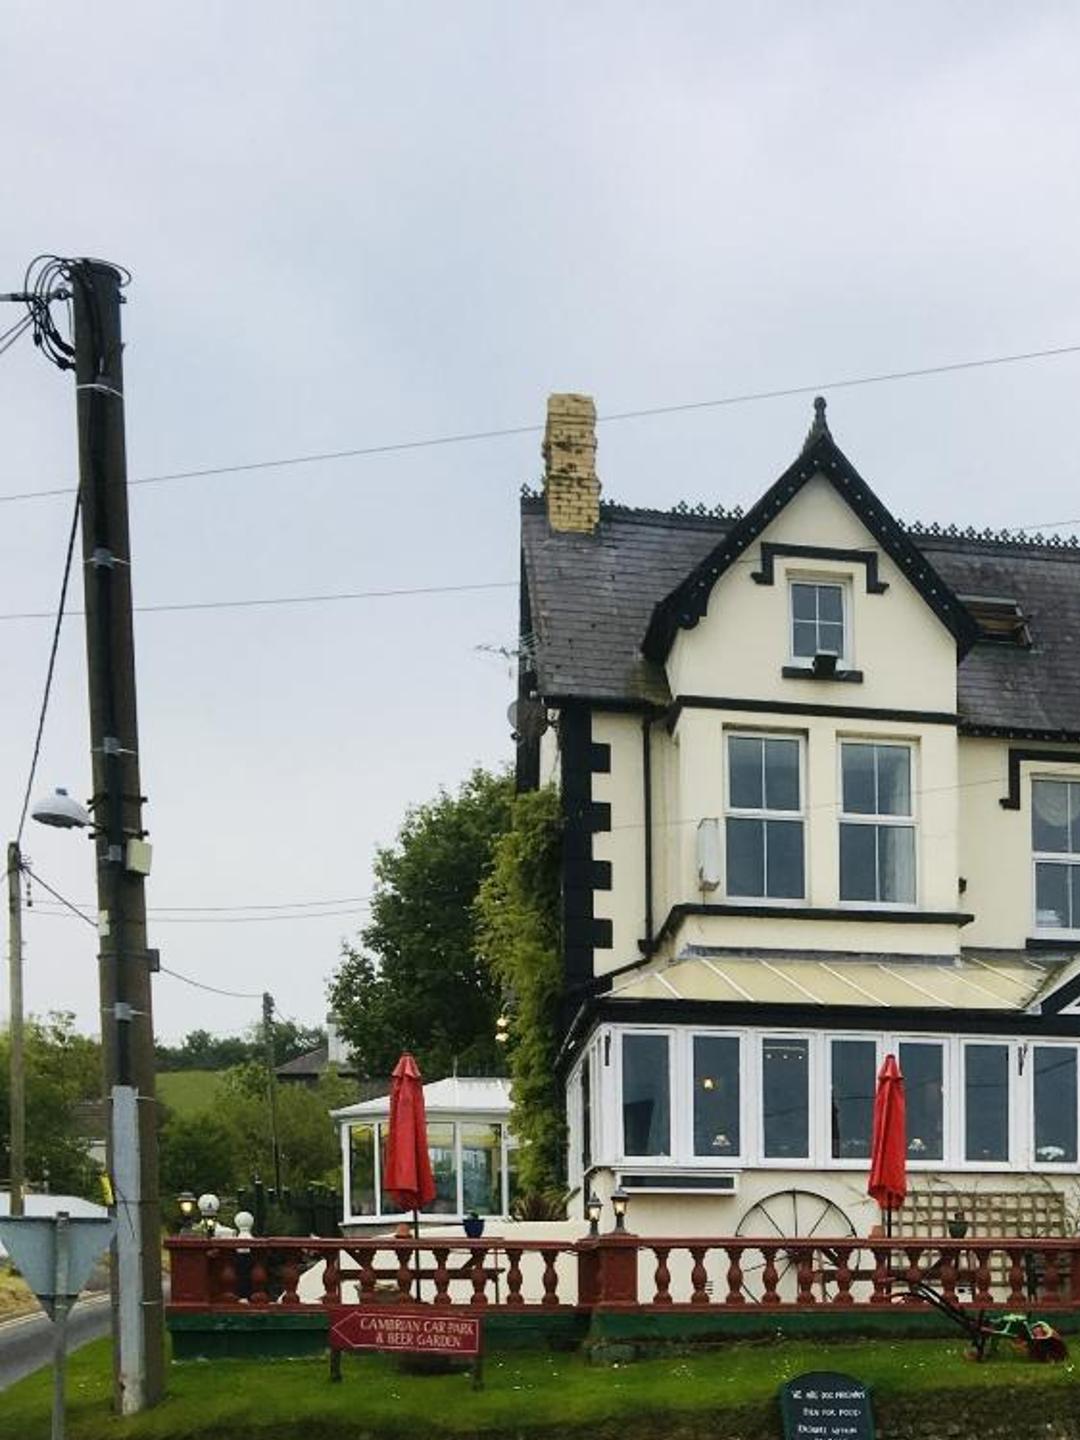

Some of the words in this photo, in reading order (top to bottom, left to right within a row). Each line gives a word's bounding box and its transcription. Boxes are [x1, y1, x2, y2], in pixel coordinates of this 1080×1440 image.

[360, 1317, 421, 1332] CAMBRIAN
[423, 1320, 446, 1334] CAR
[448, 1322, 475, 1336] PARK
[375, 1331, 384, 1344] &
[387, 1332, 414, 1346] BEER
[416, 1334, 461, 1348] GARDEN
